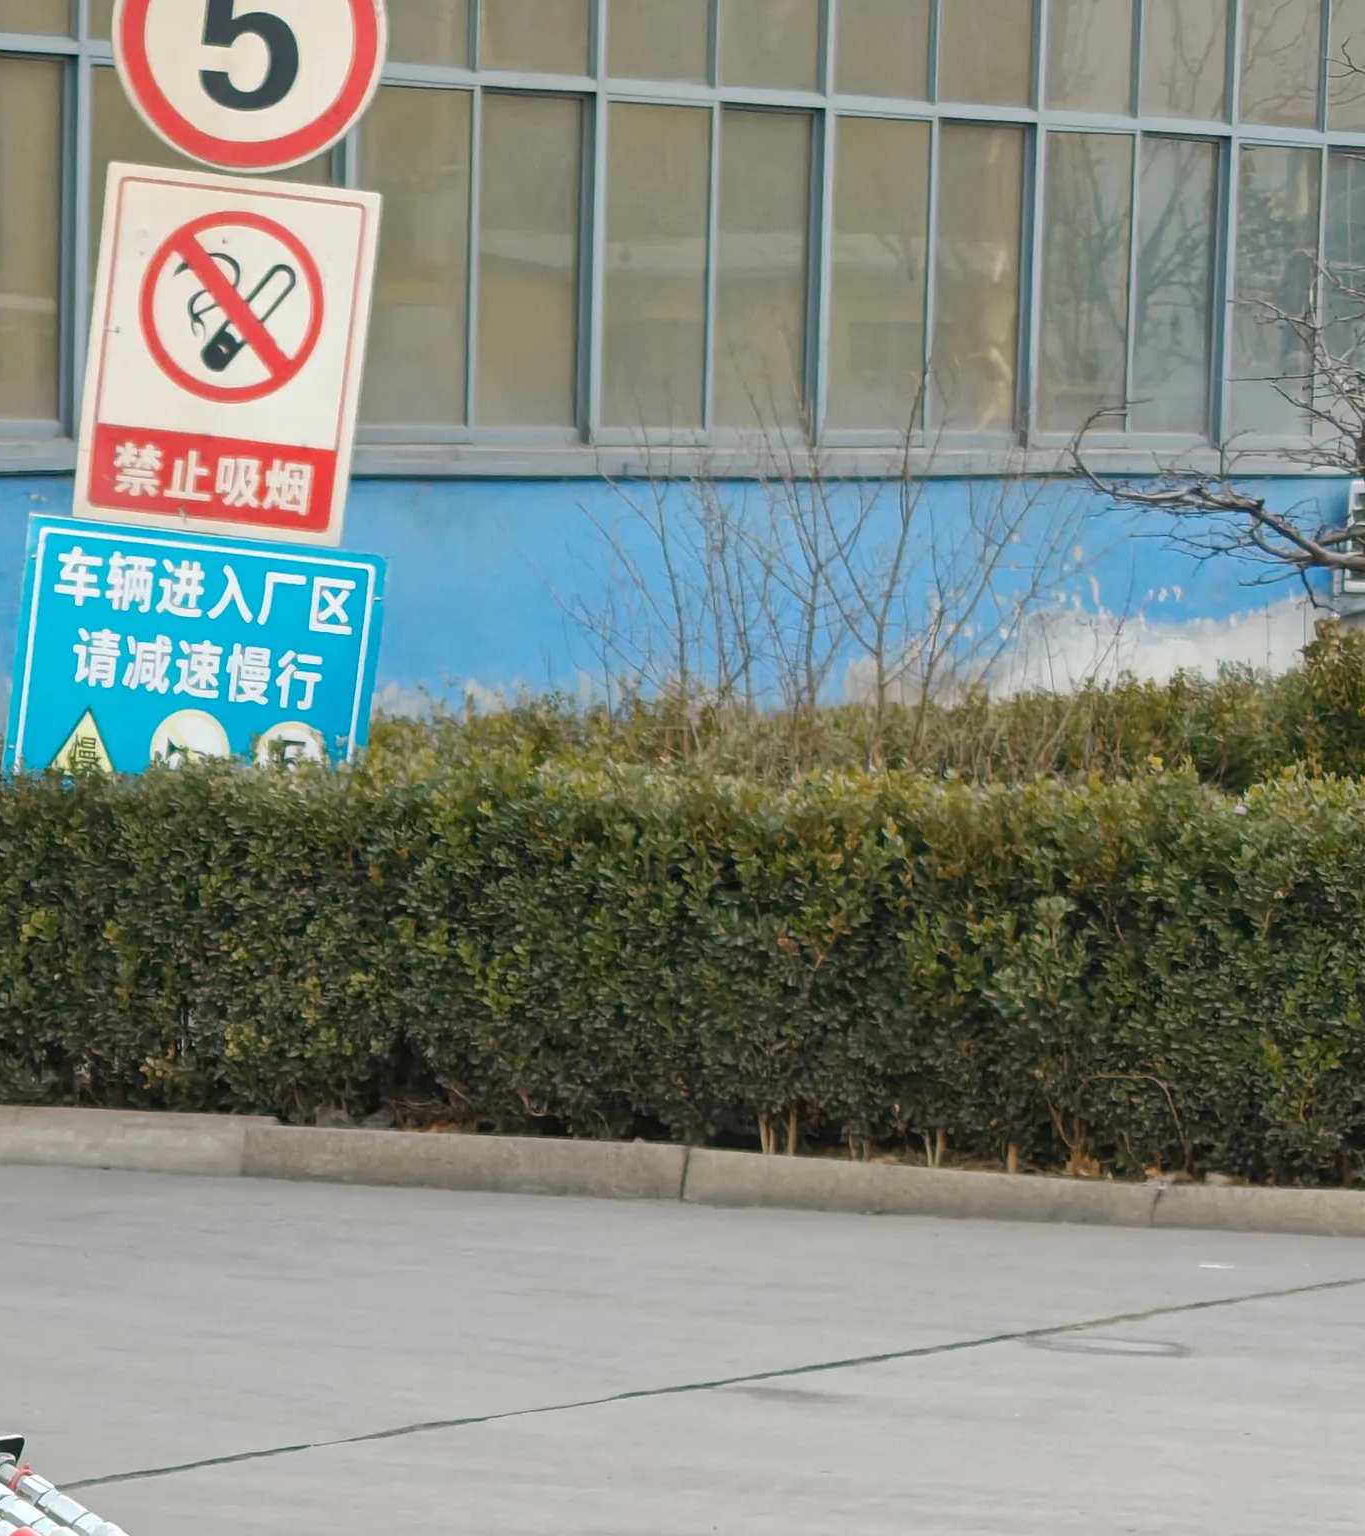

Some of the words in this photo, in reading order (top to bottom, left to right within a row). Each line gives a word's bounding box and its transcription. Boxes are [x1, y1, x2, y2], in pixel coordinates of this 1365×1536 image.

[199, 0, 299, 111] 5
[112, 441, 314, 516] 禁止吸烟
[54, 546, 357, 635] 车辆进入厂区
[73, 628, 323, 710] 请减速慢行
